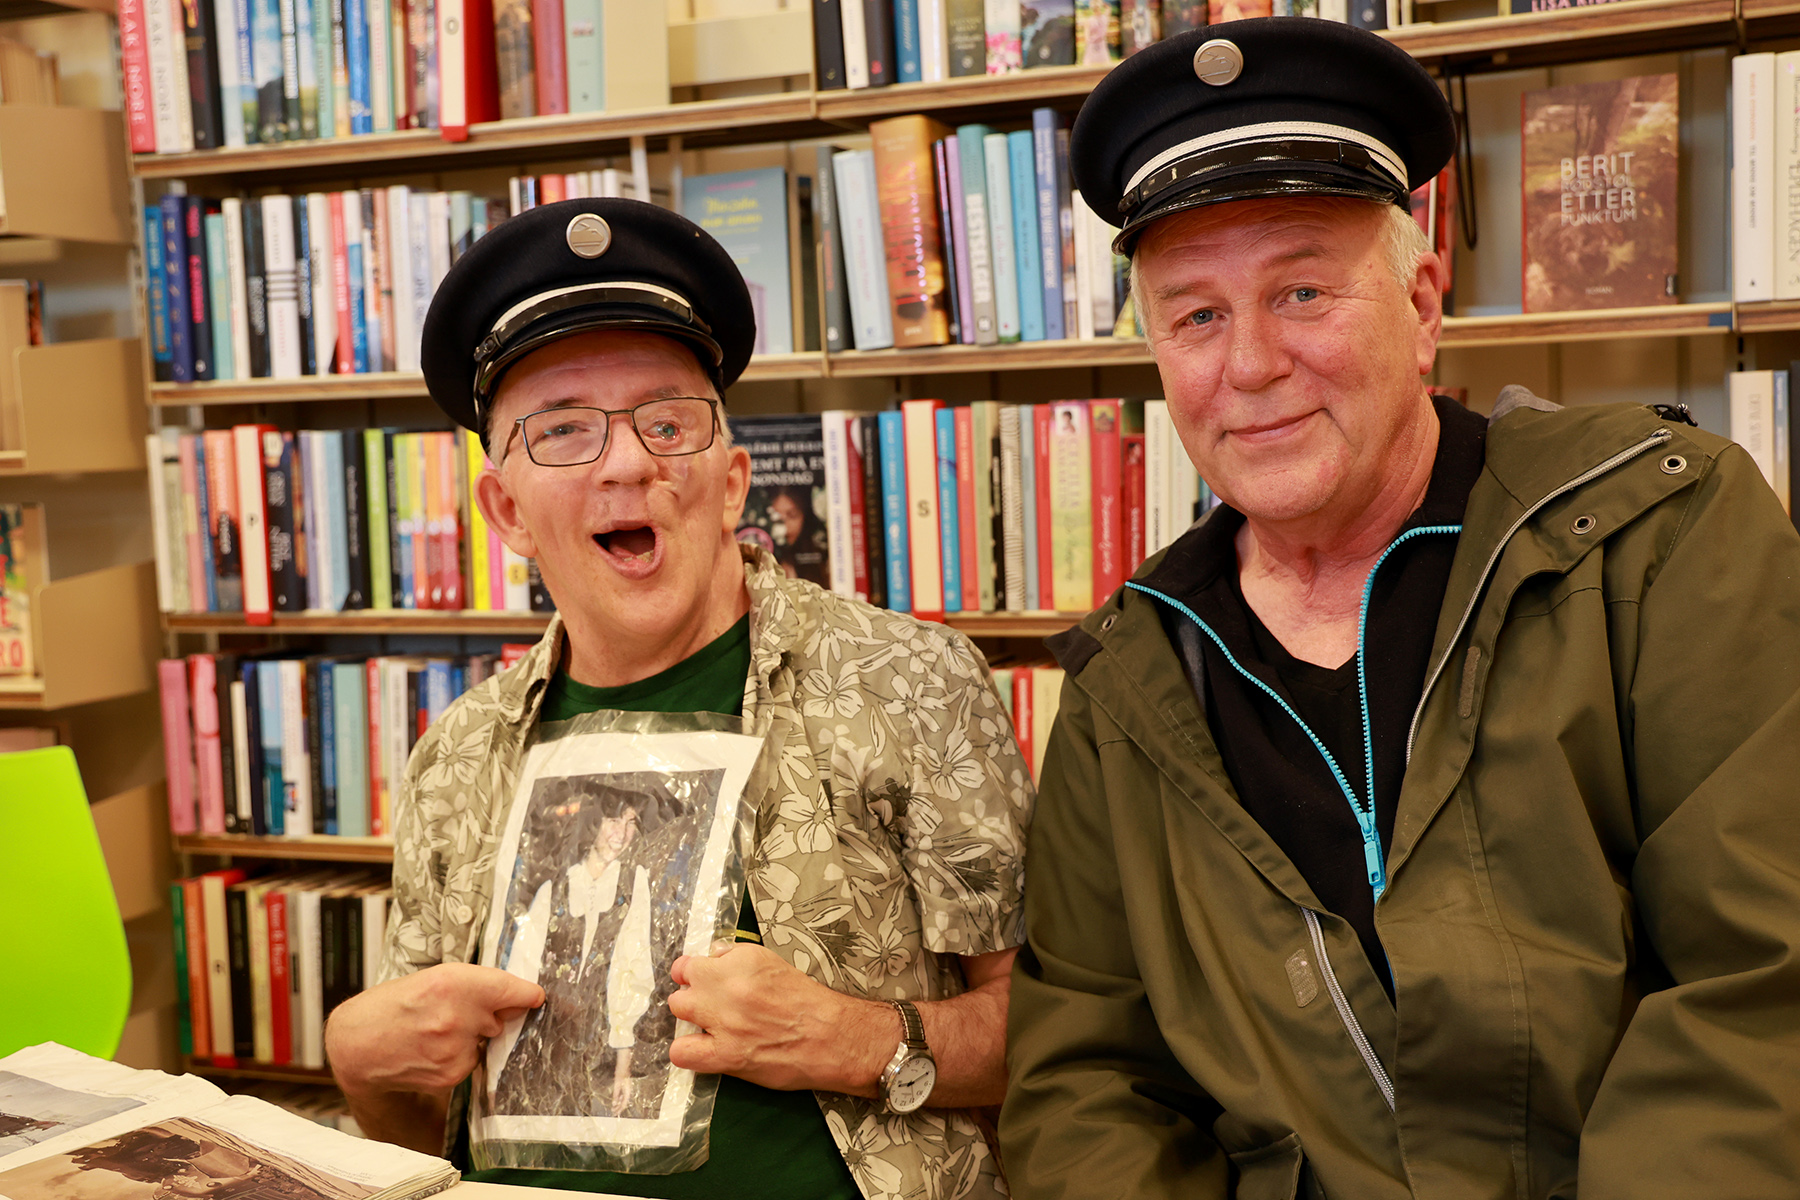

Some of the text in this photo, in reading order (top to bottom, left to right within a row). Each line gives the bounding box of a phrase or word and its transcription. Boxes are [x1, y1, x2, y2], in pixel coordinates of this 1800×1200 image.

[127, 65, 146, 125] NORE
[1560, 151, 1636, 181] BERIT
[1561, 187, 1637, 213] ETTER
[1561, 207, 1637, 227] PUNKTUM
[966, 193, 992, 304] BESTSELGER
[786, 455, 807, 471] PÅ
[751, 470, 814, 487] SØNDAG
[917, 500, 931, 517] S
